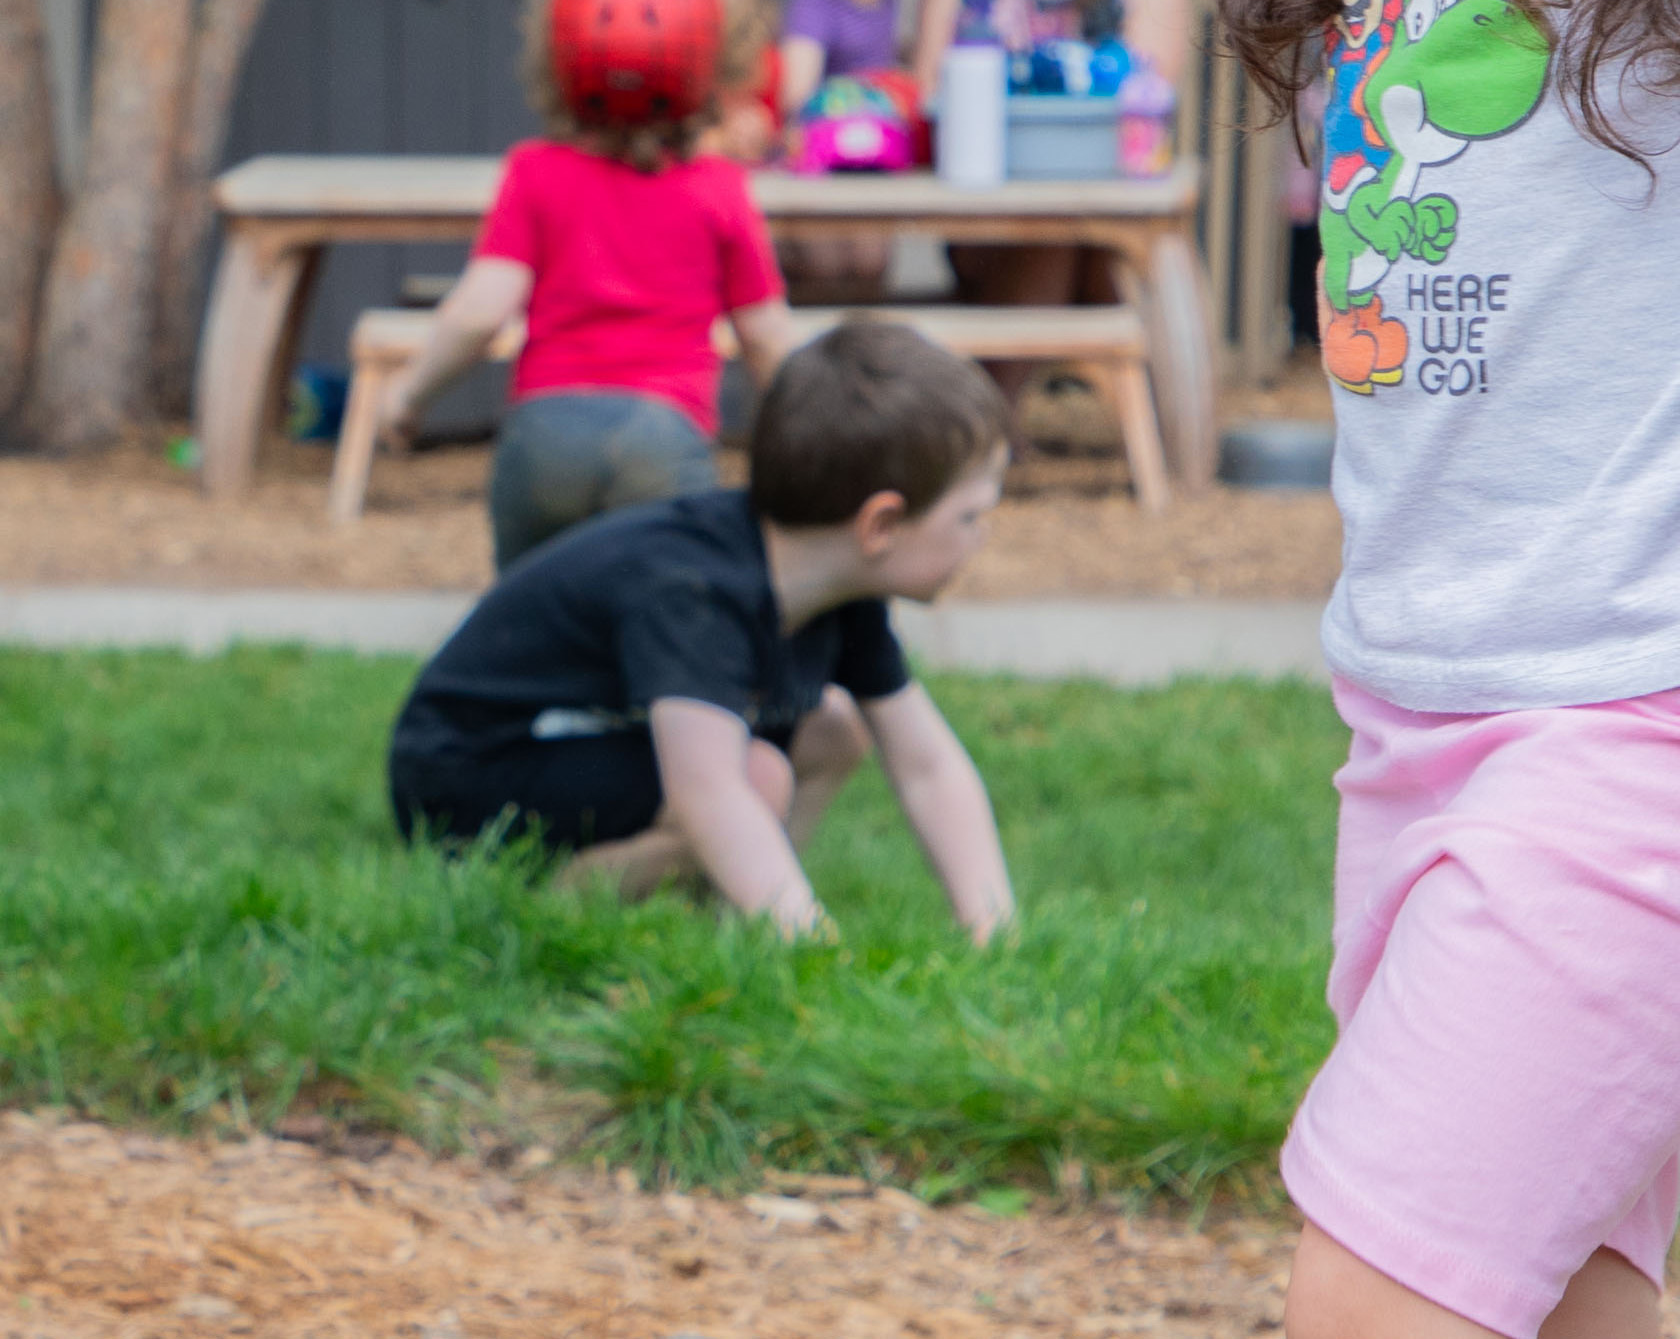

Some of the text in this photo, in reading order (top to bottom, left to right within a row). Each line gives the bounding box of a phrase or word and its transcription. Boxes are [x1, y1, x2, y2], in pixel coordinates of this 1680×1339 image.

[1407, 274, 1511, 312] HERE
[1421, 316, 1488, 354] WE
[1418, 357, 1488, 396] GO!
